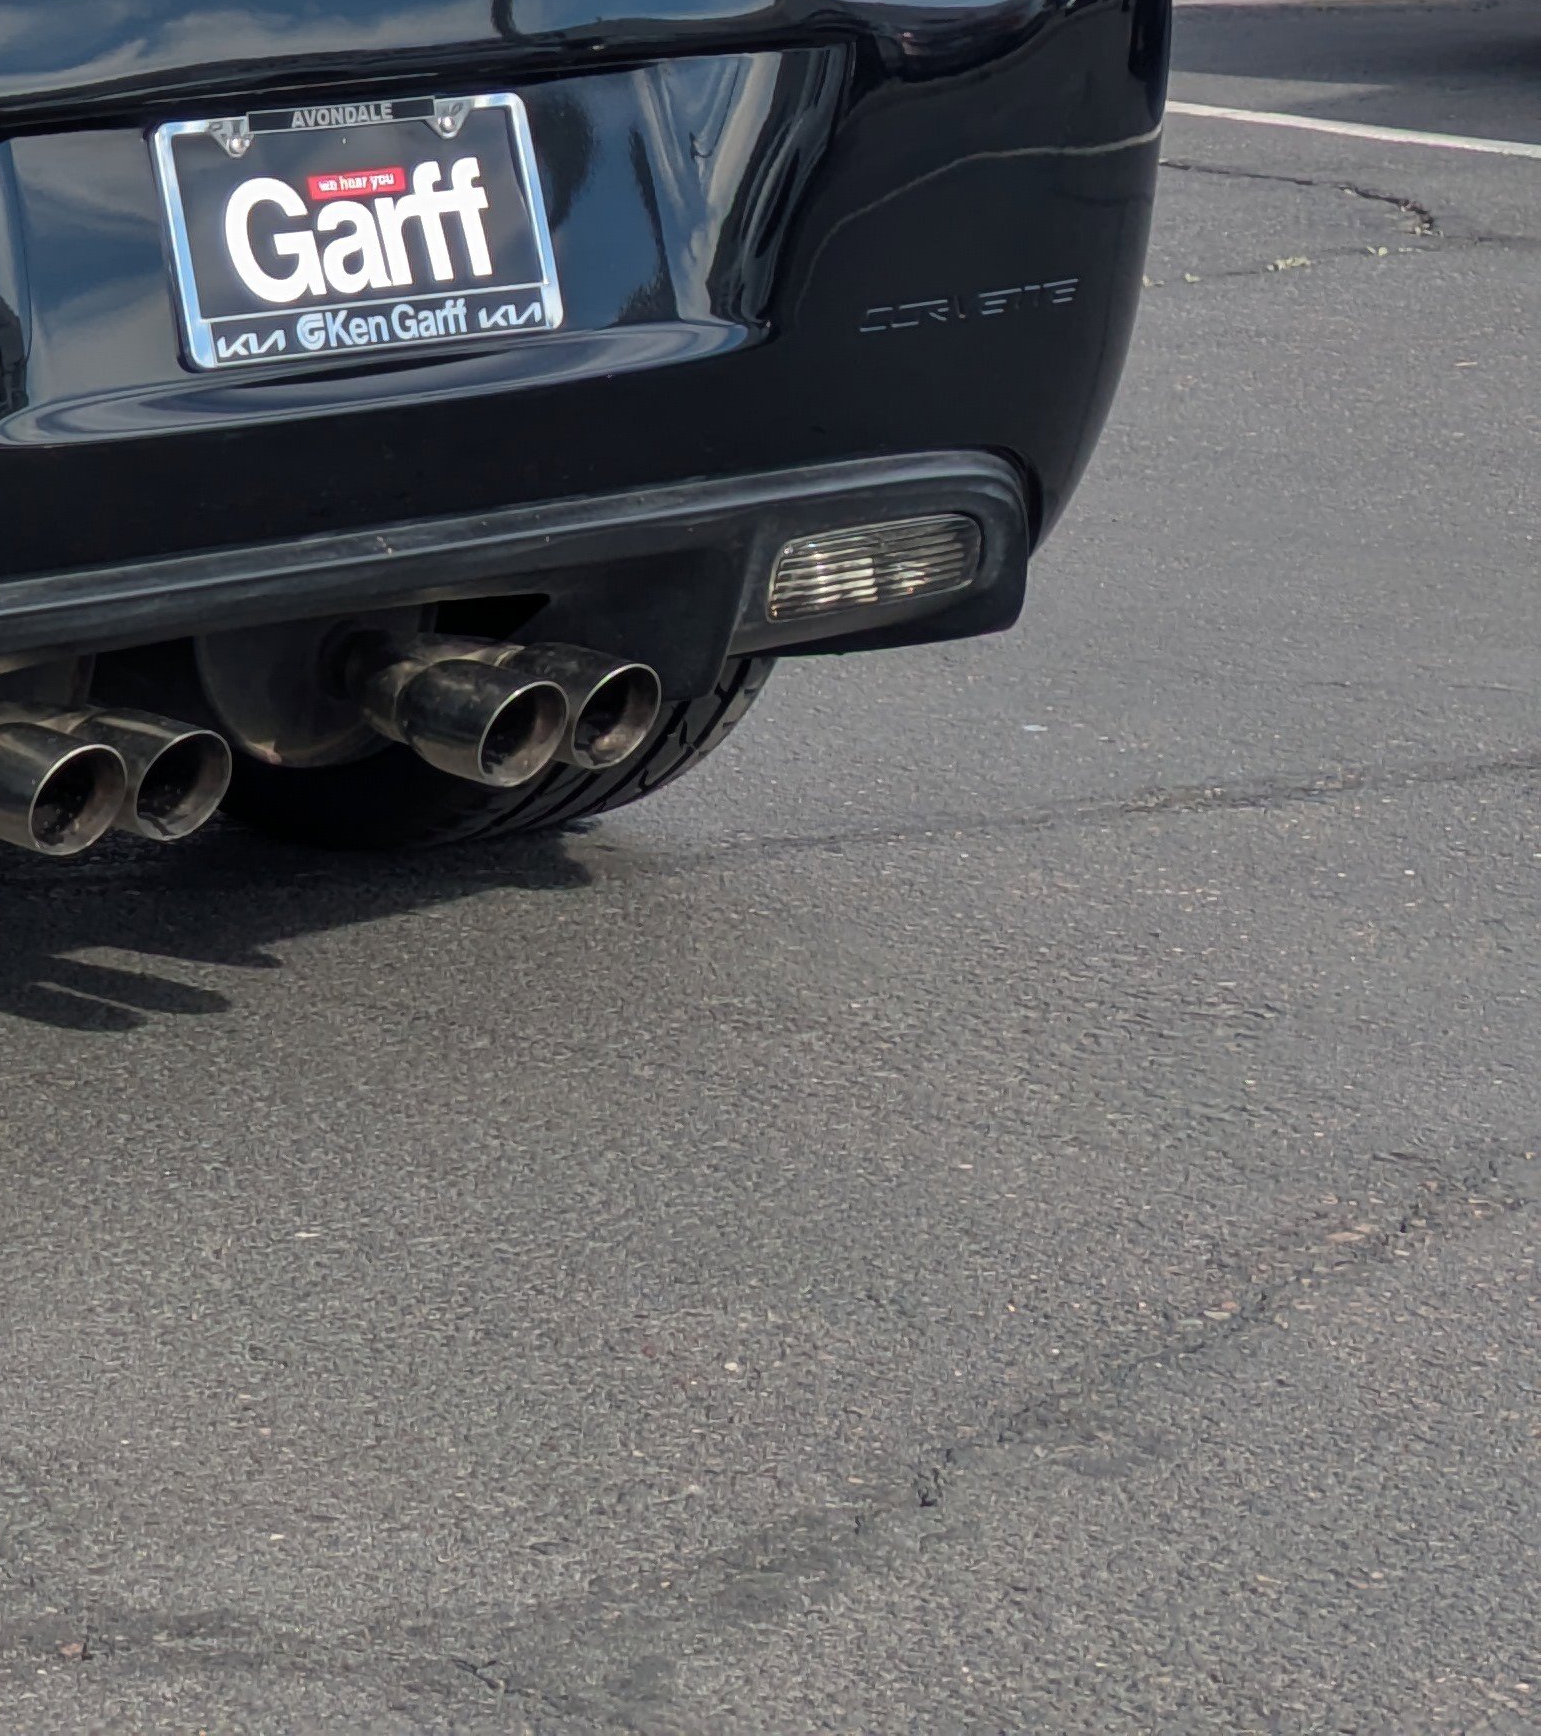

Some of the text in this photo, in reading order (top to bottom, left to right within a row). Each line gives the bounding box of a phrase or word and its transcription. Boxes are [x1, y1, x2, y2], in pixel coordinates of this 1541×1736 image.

[291, 103, 394, 129] AVONDALE
[339, 175, 368, 191] hear
[369, 173, 395, 192] you
[224, 157, 494, 303] Garff
[327, 298, 467, 348] Ken Garff
[478, 301, 542, 329] KIA
[217, 328, 286, 359] KIA
